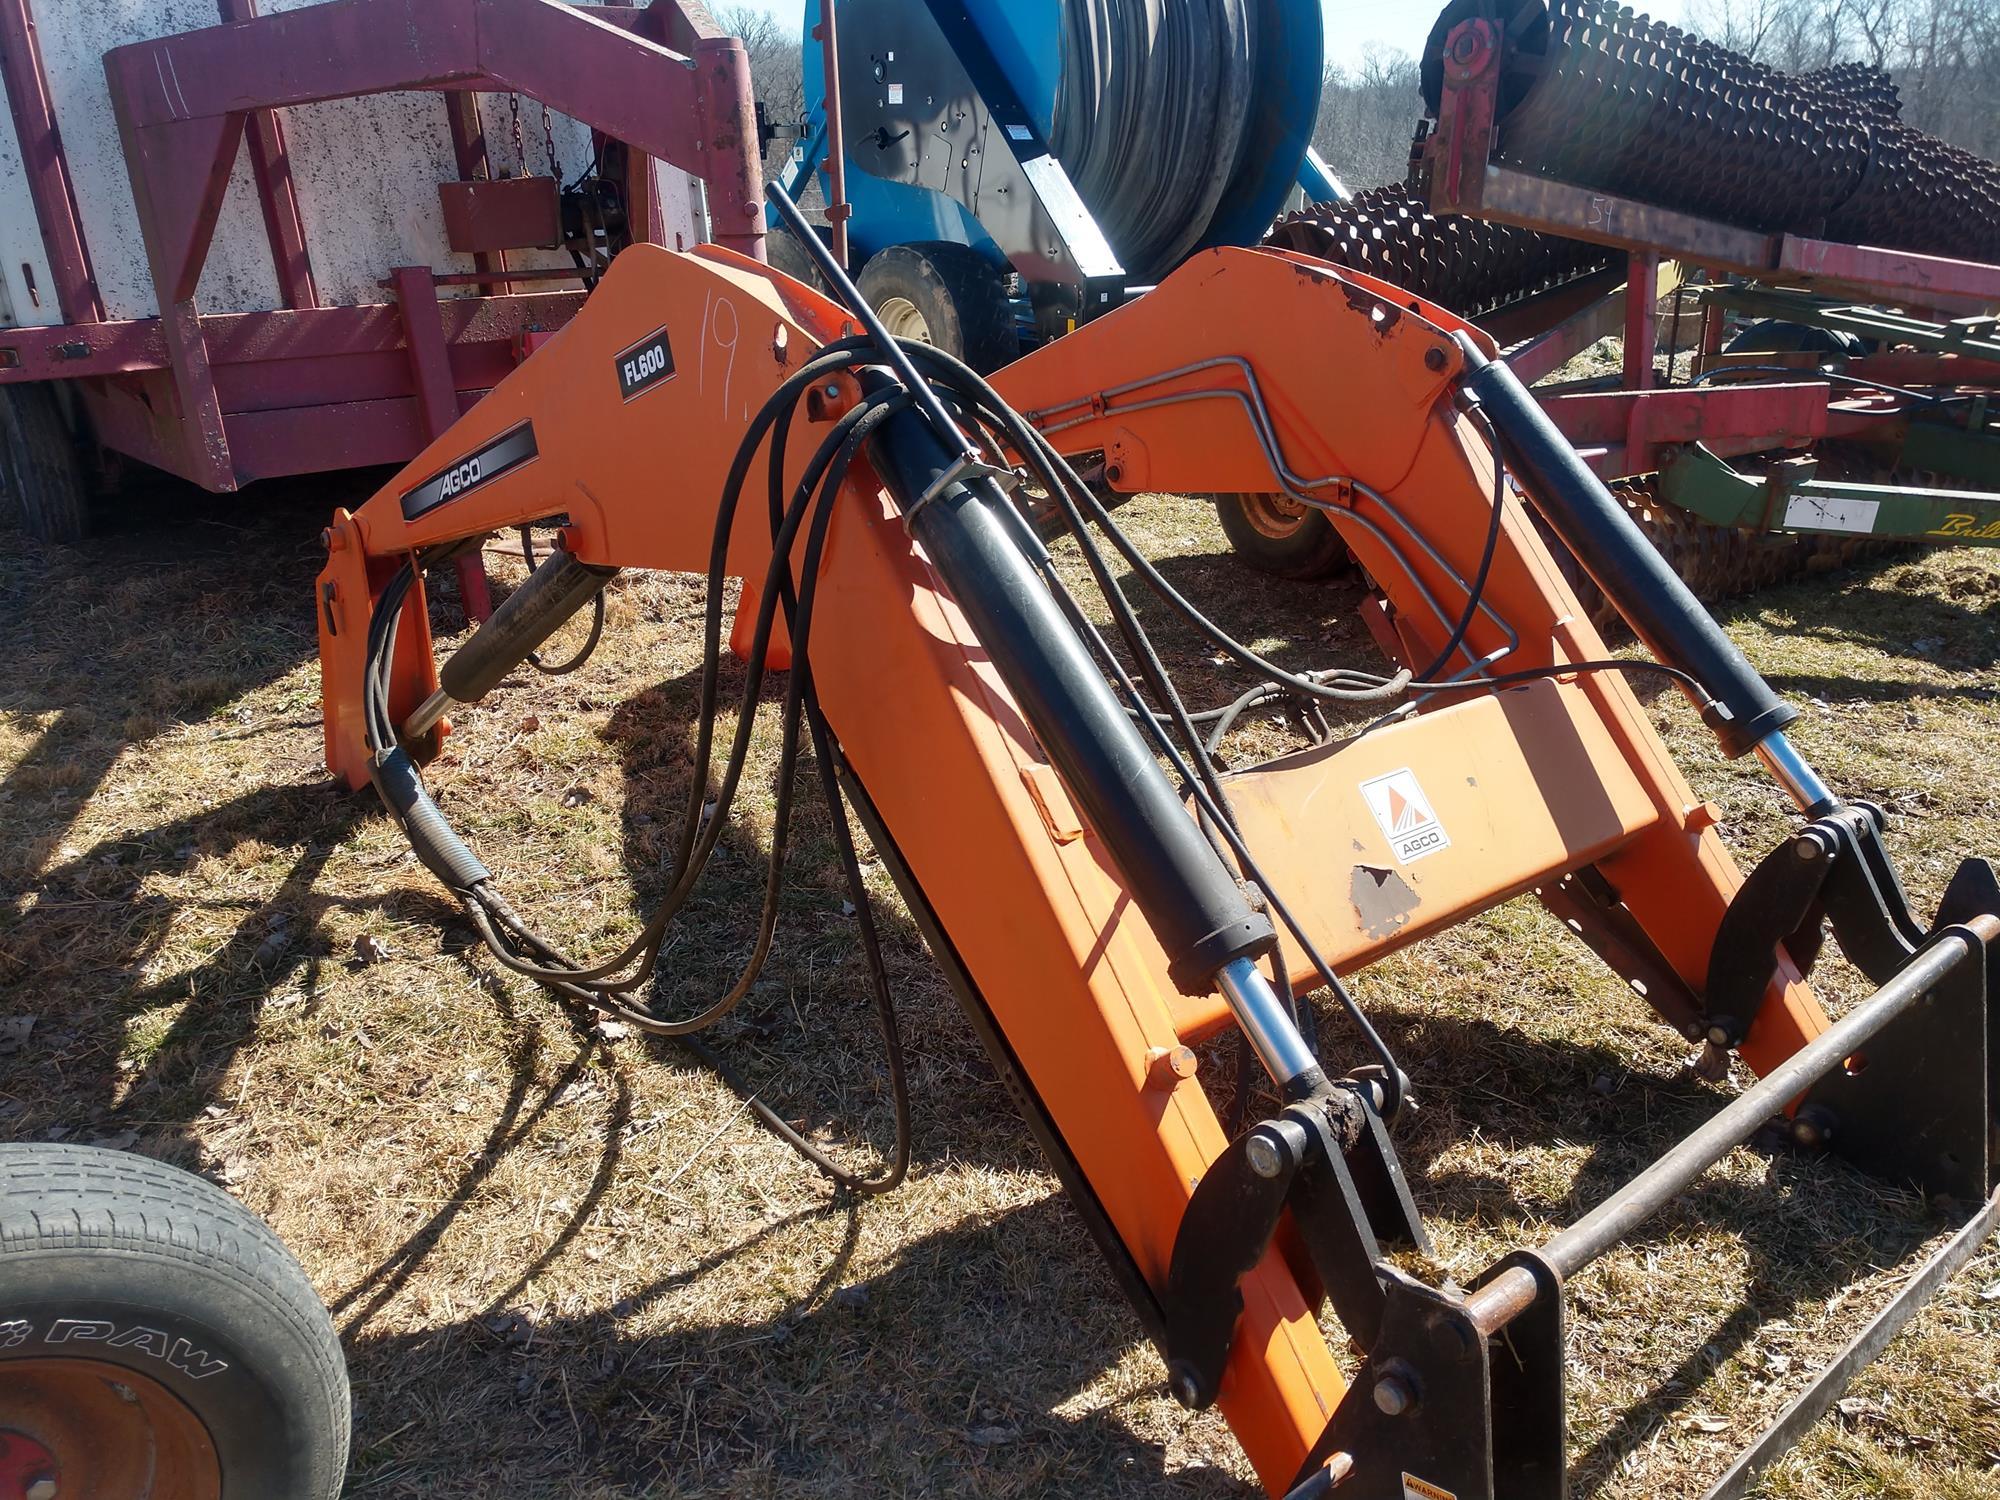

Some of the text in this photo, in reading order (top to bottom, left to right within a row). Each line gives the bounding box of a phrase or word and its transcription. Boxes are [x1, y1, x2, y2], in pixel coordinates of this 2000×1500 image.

[624, 345, 665, 386] FL600
[440, 458, 480, 500] AGCO
[1402, 832, 1439, 855] AGCO
[44, 1319, 229, 1379] PAW
